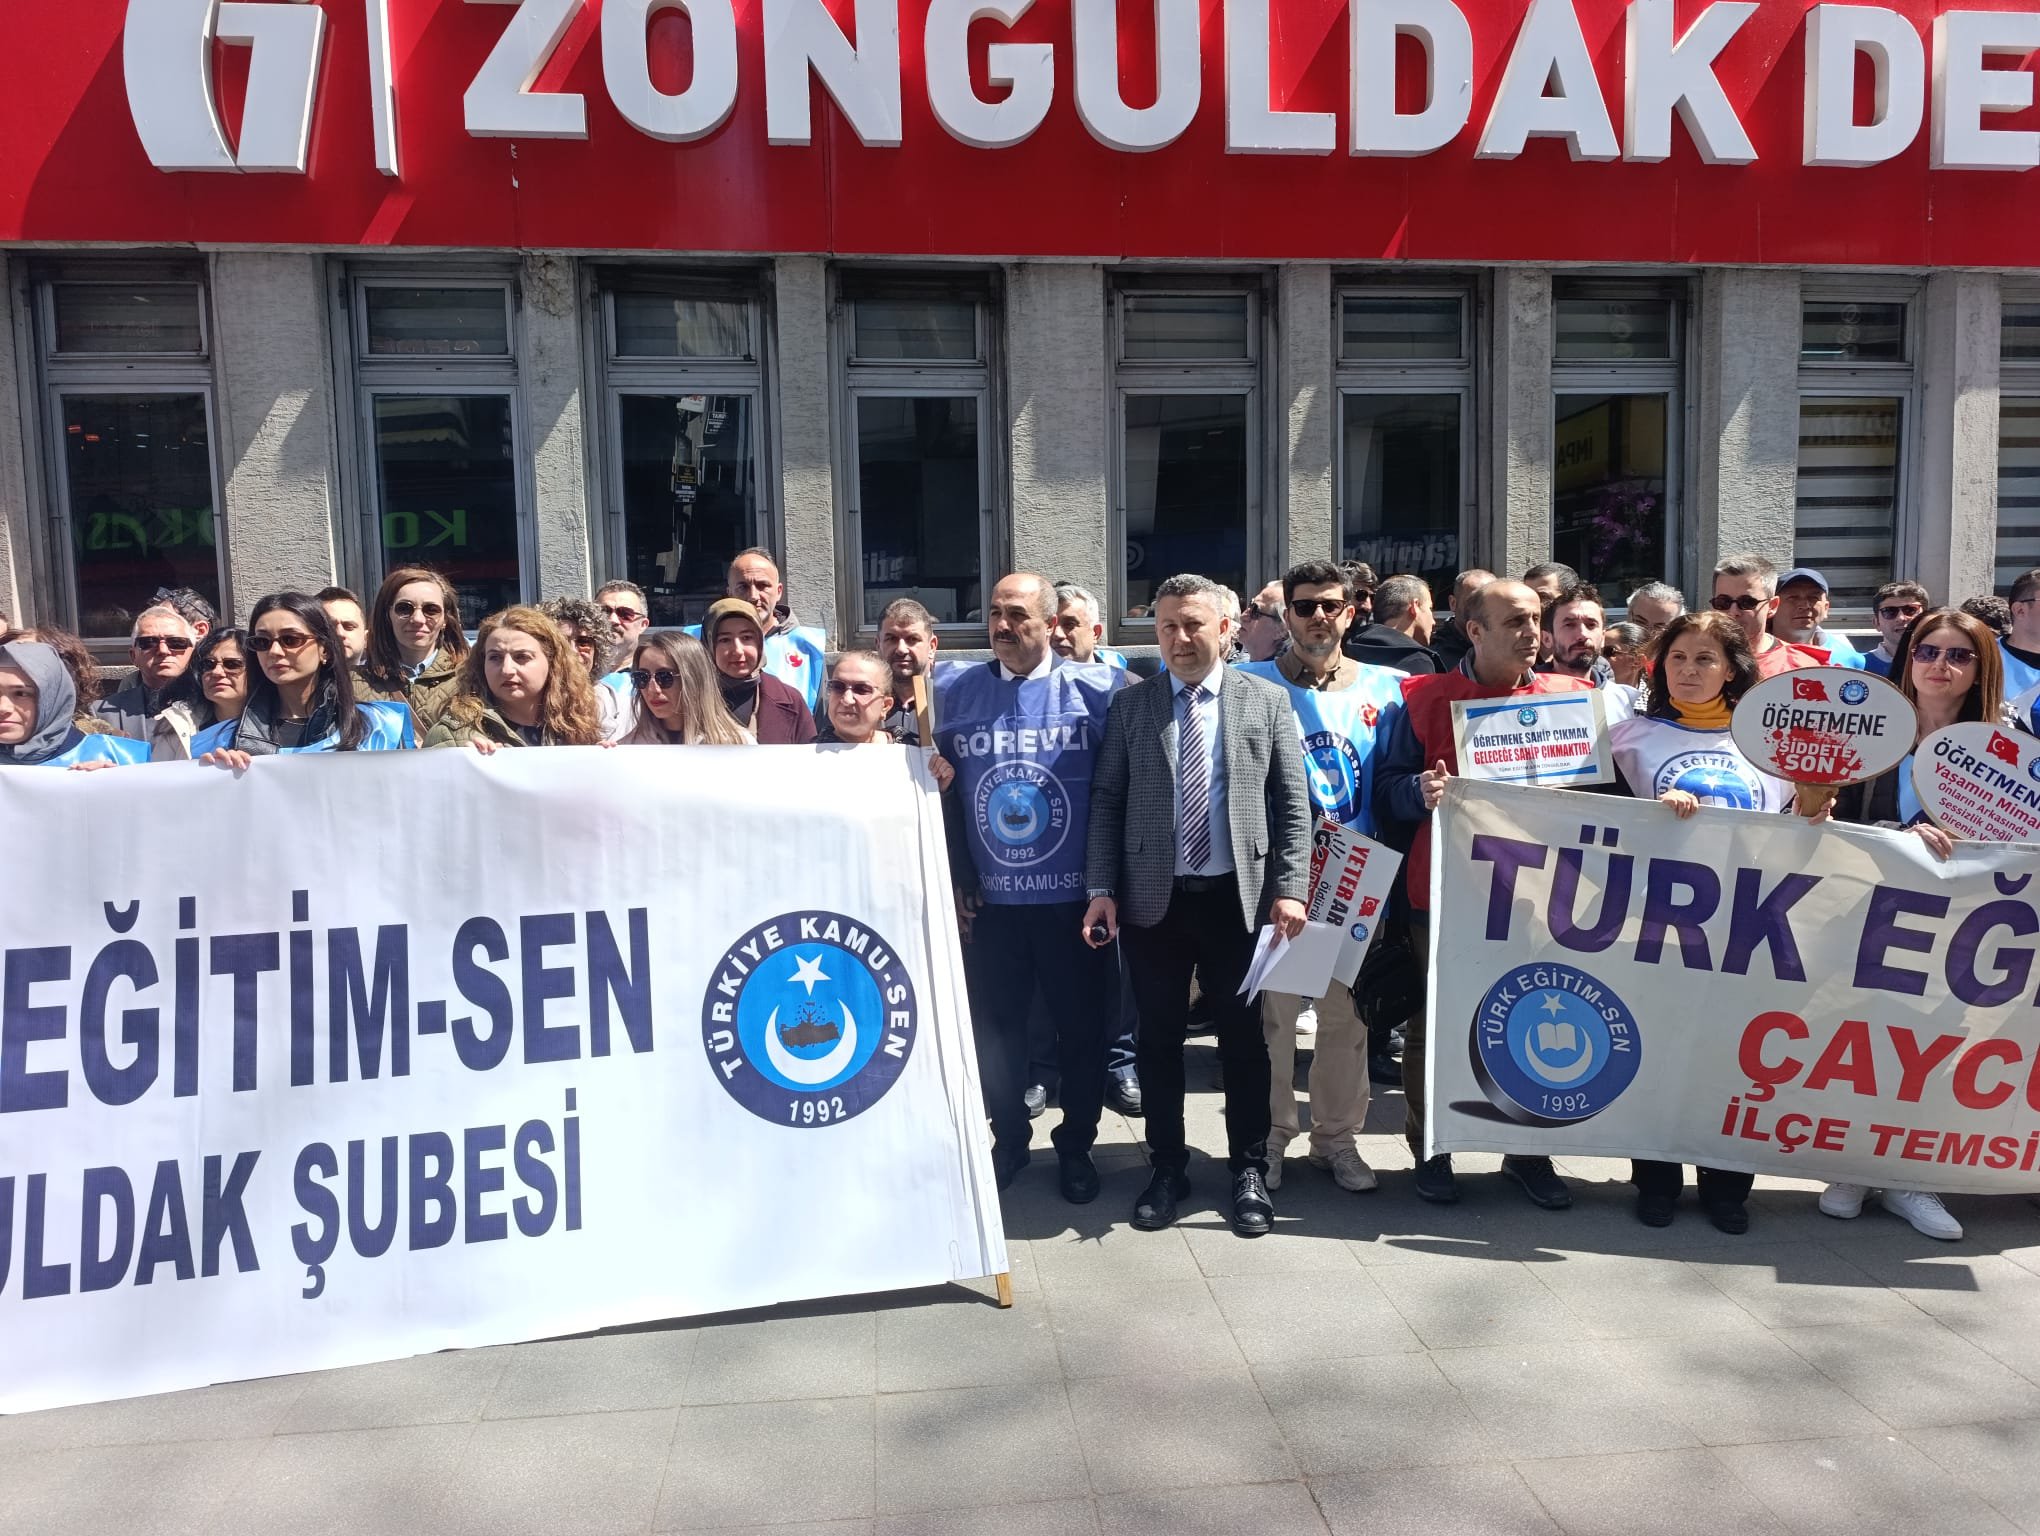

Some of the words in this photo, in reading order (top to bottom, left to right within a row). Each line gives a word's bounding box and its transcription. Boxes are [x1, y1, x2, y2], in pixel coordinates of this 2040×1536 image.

[464, 0, 1759, 165] ZONGULDAK
[953, 720, 1089, 758] GÖREVLİ
[1472, 733, 1524, 748] ÖĞRETMENE
[1525, 731, 1551, 745] SAHİP
[1553, 727, 1589, 742] ÇIKMAK
[1762, 702, 1888, 737] ÖĞRETMENE
[1474, 749, 1514, 765] GELECEĞE
[1514, 744, 1540, 762] SAHİP
[1541, 741, 1592, 761] ÇIKMAKTIR!
[1779, 737, 1852, 758] ŞİDDETE
[1934, 737, 2040, 812] ÖĞRETMEN
[1935, 762, 1994, 802] Yaşamın
[976, 770, 1003, 832] TÜRKİYE
[1938, 782, 1976, 808] Onların
[1976, 805, 2029, 838] Arkasında
[1939, 797, 1985, 827] Sessizlik
[1985, 823, 2014, 842] Değil
[1940, 812, 1977, 838] Direniş
[1005, 847, 1036, 860] 1992
[1014, 871, 1088, 892] KAMU-SEN
[1471, 825, 1823, 982] TÜRK
[1852, 871, 2040, 1008] EĞ
[0, 889, 654, 1114] EĞİTİM-SEN
[708, 924, 785, 1080] TÜRKİYE
[1482, 987, 1517, 1049] TÜRK
[1516, 967, 1631, 1053] EĞİTİM-SEN
[789, 1096, 847, 1124] 1992
[1541, 1092, 1590, 1112] 1992
[1721, 1096, 1851, 1154] İLÇE
[1869, 1123, 2040, 1172] TEMSİ
[290, 1088, 582, 1300] ŞUBESİ
